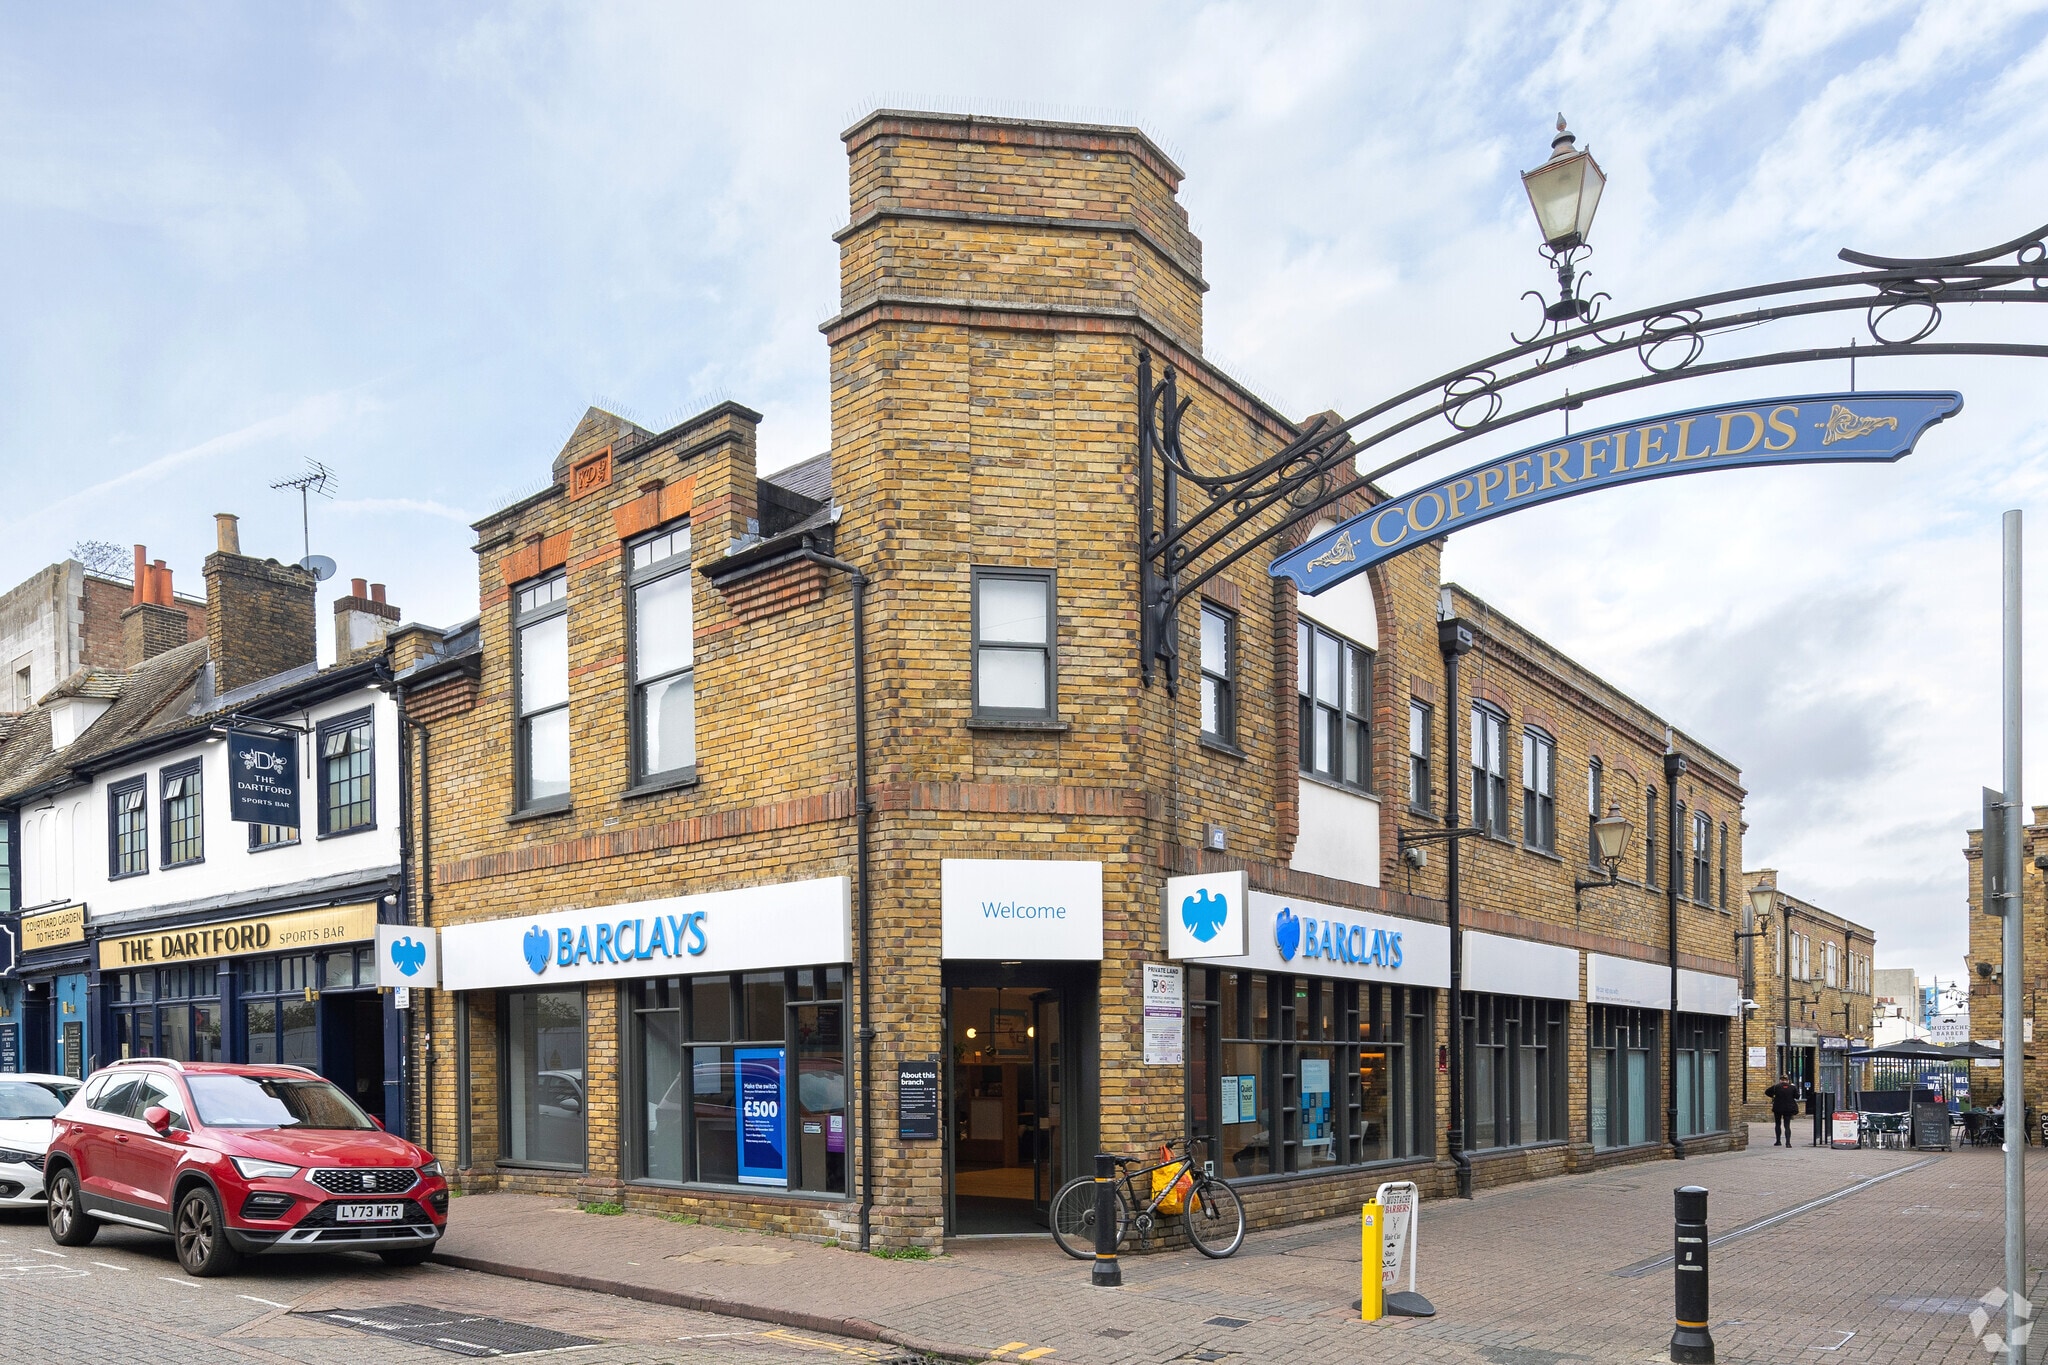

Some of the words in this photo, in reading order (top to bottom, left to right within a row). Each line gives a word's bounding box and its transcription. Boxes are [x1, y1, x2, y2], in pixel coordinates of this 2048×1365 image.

[1371, 405, 1799, 547] COPPERFIELDS
[254, 774, 275, 784] THE
[237, 781, 292, 796] DARTFORD
[241, 797, 273, 806] SPORTS
[981, 901, 1067, 920] Welcome
[25, 916, 57, 933] COURTYARD
[57, 911, 82, 927] GARDEN
[36, 933, 44, 943] TO
[44, 931, 55, 940] THE
[55, 928, 71, 939] REAR
[119, 938, 155, 963] THE
[161, 922, 271, 958] DARTFORD
[279, 928, 320, 945] SPORTS
[323, 925, 345, 939] BAR
[556, 911, 708, 967] BARCLAYS
[1302, 917, 1403, 969] BARCLAYS
[1241, 1085, 1253, 1094] Quiet
[1242, 1093, 1252, 1101] hour
[744, 1100, 778, 1118] £500
[1386, 1195, 1411, 1204] MUSTACHE
[342, 1206, 373, 1218] LY73
[376, 1205, 399, 1217] WTR
[1385, 1204, 1409, 1213] BARBERS
[1381, 1270, 1395, 1282] PEN
